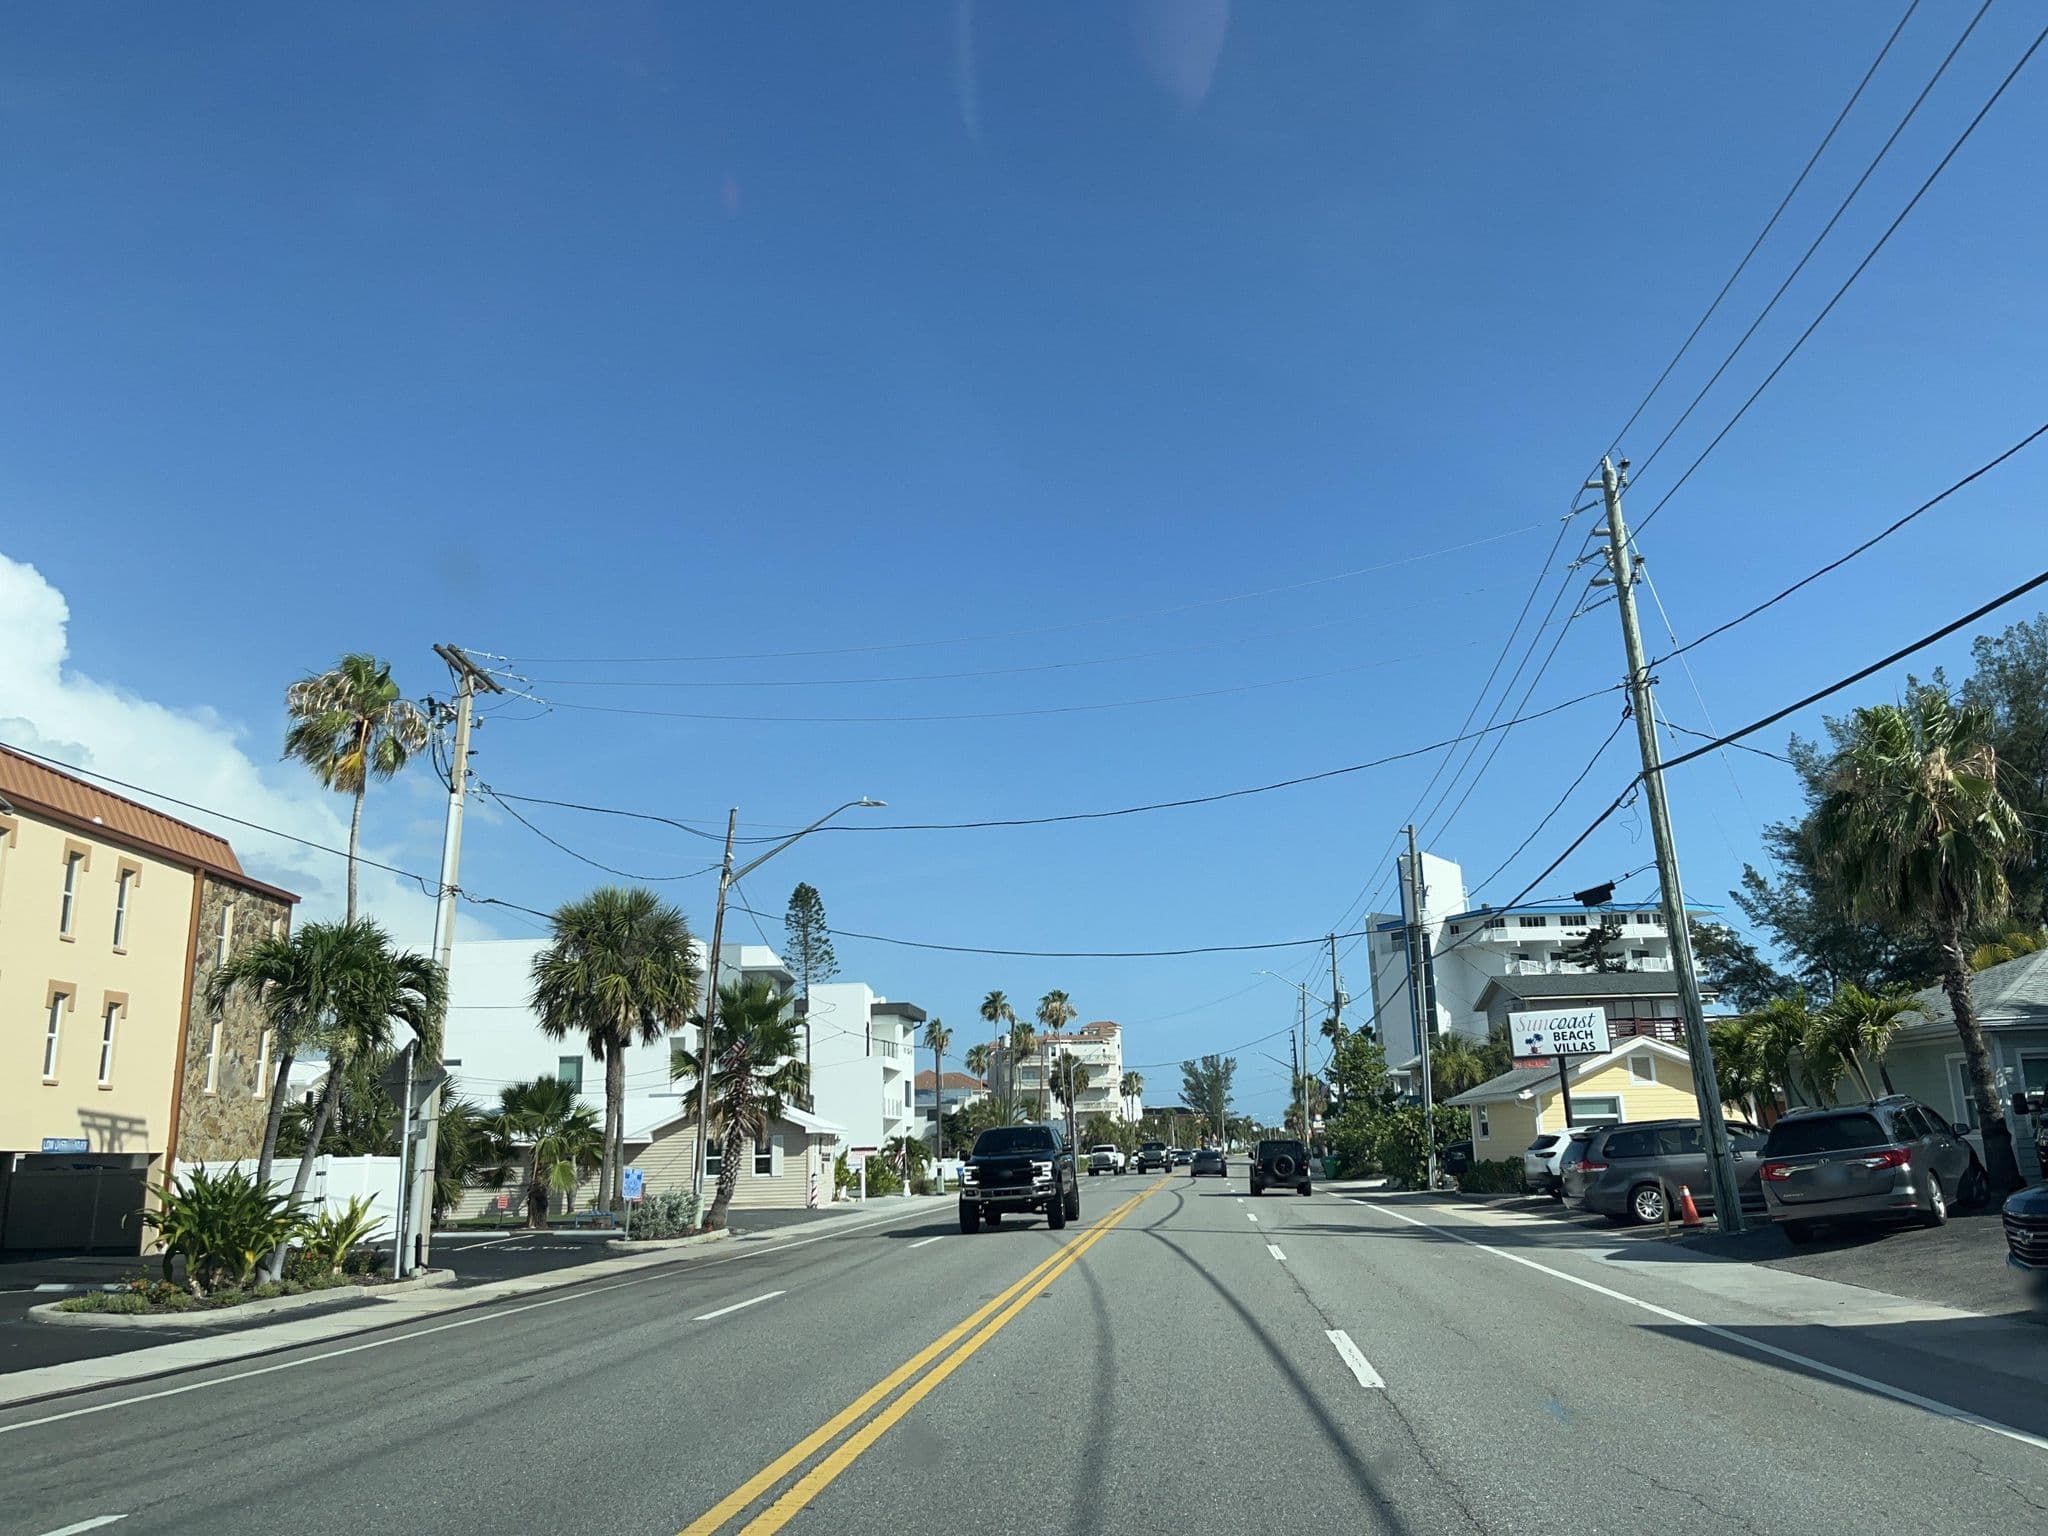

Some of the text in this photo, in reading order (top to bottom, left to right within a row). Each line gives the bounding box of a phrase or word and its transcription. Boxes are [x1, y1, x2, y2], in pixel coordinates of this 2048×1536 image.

[1516, 1013, 1596, 1032] Suncoast
[1553, 1030, 1594, 1042] BEACH
[1553, 1041, 1596, 1053] VILLAS
